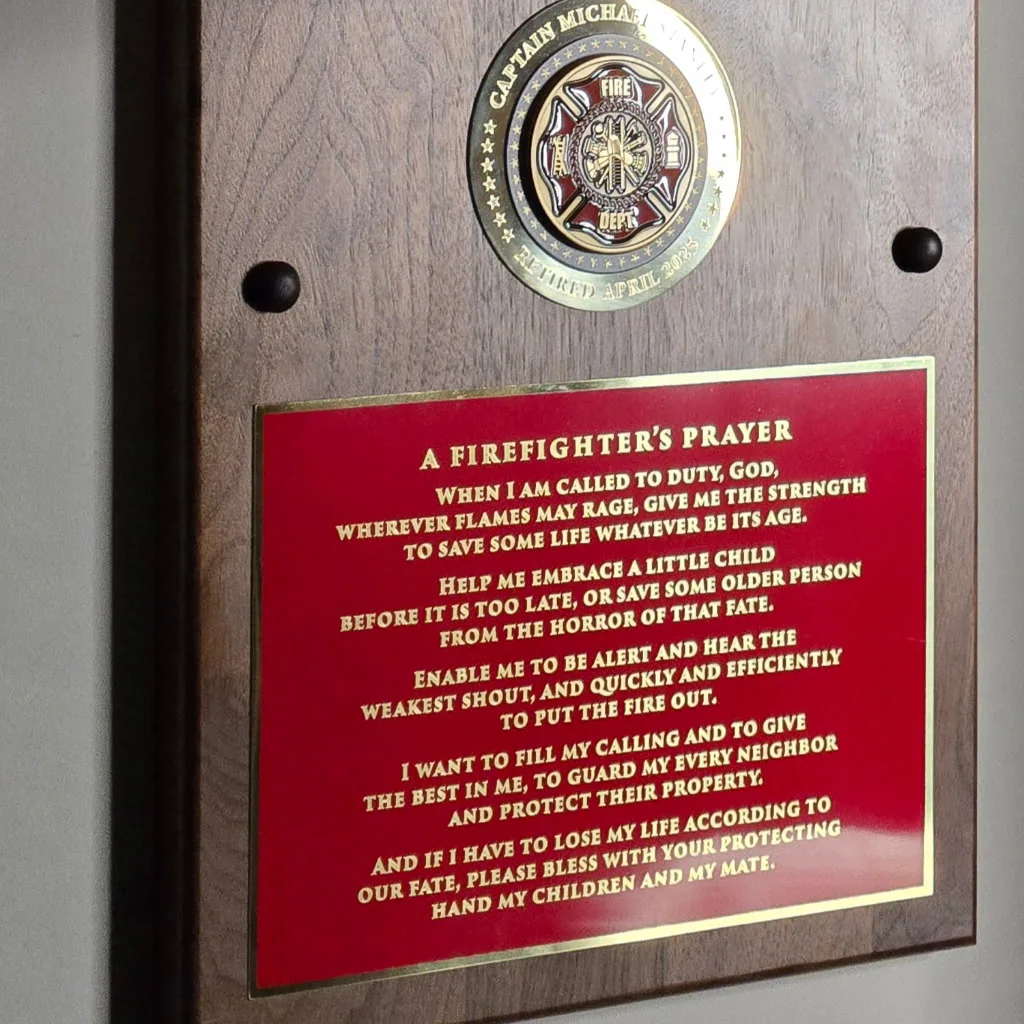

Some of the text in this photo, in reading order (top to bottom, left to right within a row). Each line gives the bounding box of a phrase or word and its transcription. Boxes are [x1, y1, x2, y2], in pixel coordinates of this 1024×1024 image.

[488, 21, 556, 110] CAPTAIN
[602, 77, 632, 98] FIRE
[599, 211, 634, 230] DEPT
[513, 244, 596, 300] RETIRED
[601, 270, 661, 301] APRIL
[418, 446, 441, 471] A
[681, 418, 793, 449] PRAYER
[334, 475, 867, 541] WHEREVER FLAMES MAY RAGE, GIVE ME THE STRENGTH
[433, 459, 779, 505] WHEN I AM CALLED TO DUTY, GOD,
[402, 505, 808, 561] TO SAVE SOME LIFE WHATEVER BE ITS AGE.
[339, 559, 862, 633] BEFORE IT IS TOO LATE, OR SAVE SOME OLDER PERSON
[438, 544, 776, 596] HELP ME EMBRACE A LITTLE CHILD
[438, 594, 775, 648] FROM THE HORROR OF THAT FATE.
[359, 646, 843, 721] WEAKEST SHOUT, AND QUICKLY AND EFFICIENTLY
[412, 627, 797, 689] ENABLE ME TO BE ALERT AND HEAR THE
[499, 687, 718, 731] TO PUT THE FIRE OUT.
[362, 732, 839, 812] THE BEST IN ME, TO GUARD MY EVERY NEIGHBOR
[400, 711, 806, 782] I WANT TO FILL MY CALLING AND TO GIVE
[446, 767, 764, 828] AND PROTECT THEIR PROPERTY.
[356, 818, 840, 904] OUR FATE, PLEASE BLESS WITH YOUR PROTECTING
[369, 794, 832, 876] AND IF I HAVE TO LOSE MY LIFE ACCORDING TO
[430, 854, 775, 920] HAND MY CHILDREN AND MY MATE.
